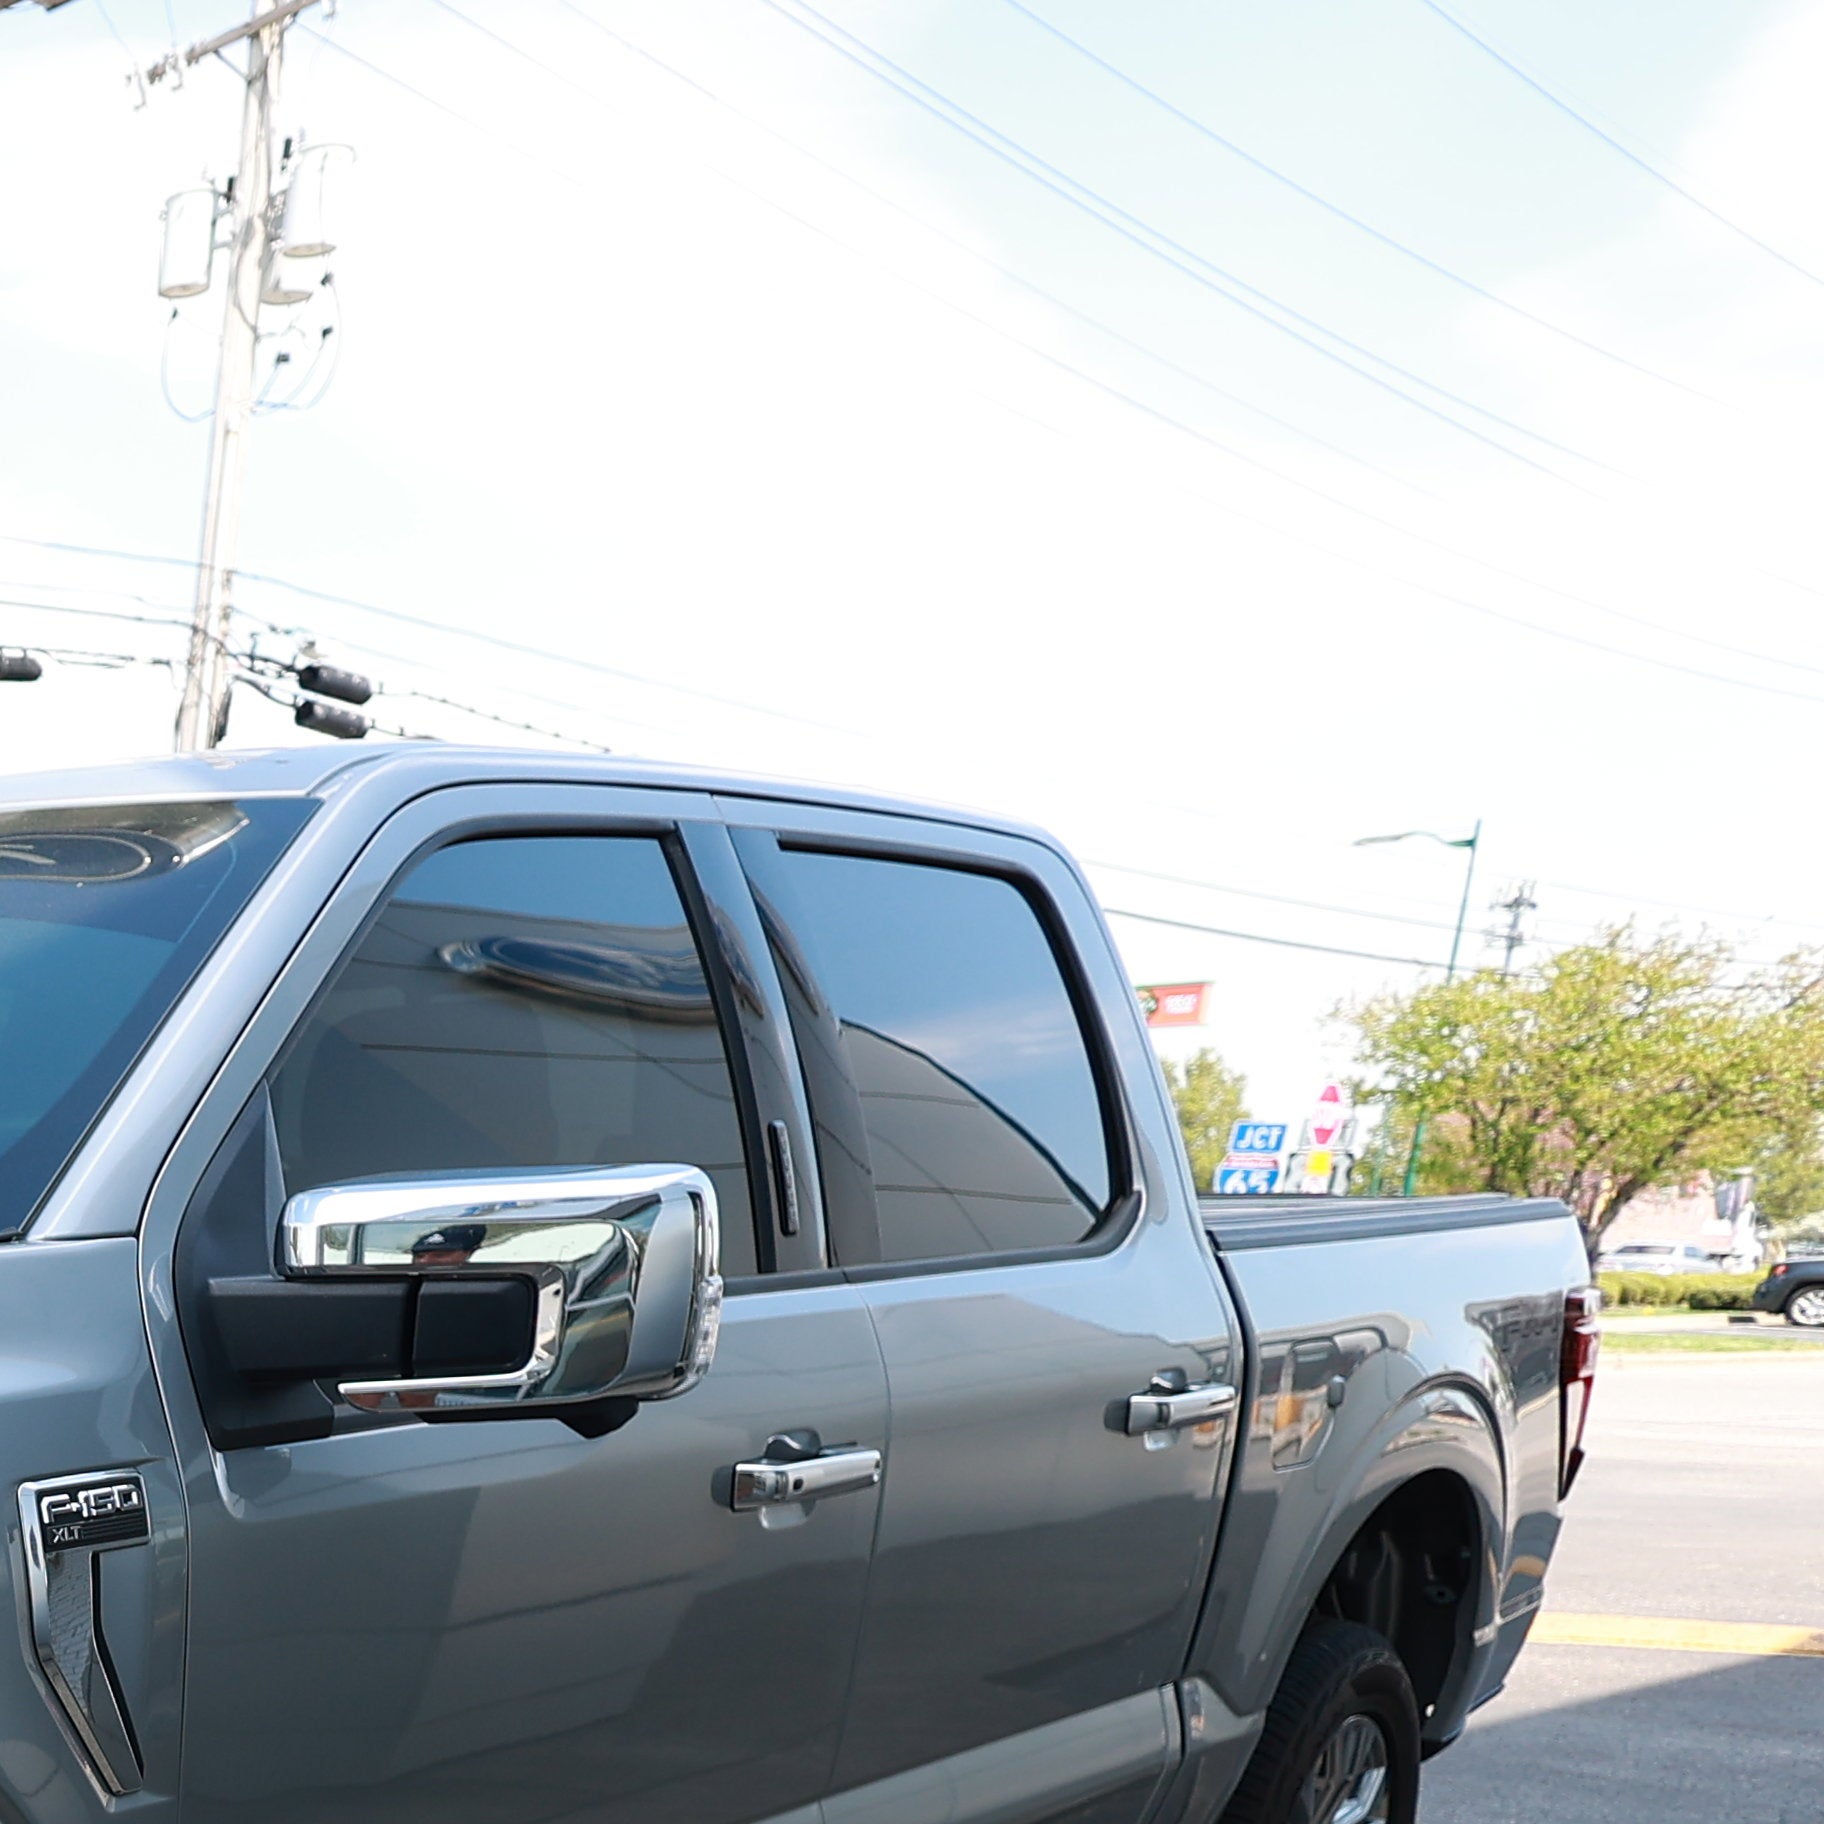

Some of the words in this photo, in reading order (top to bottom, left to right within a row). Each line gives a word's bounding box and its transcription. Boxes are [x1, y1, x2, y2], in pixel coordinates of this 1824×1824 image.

[1236, 1126, 1282, 1149] JCT
[1223, 1169, 1270, 1194] 65
[40, 1484, 144, 1524] F-150
[52, 1525, 81, 1543] XLT
